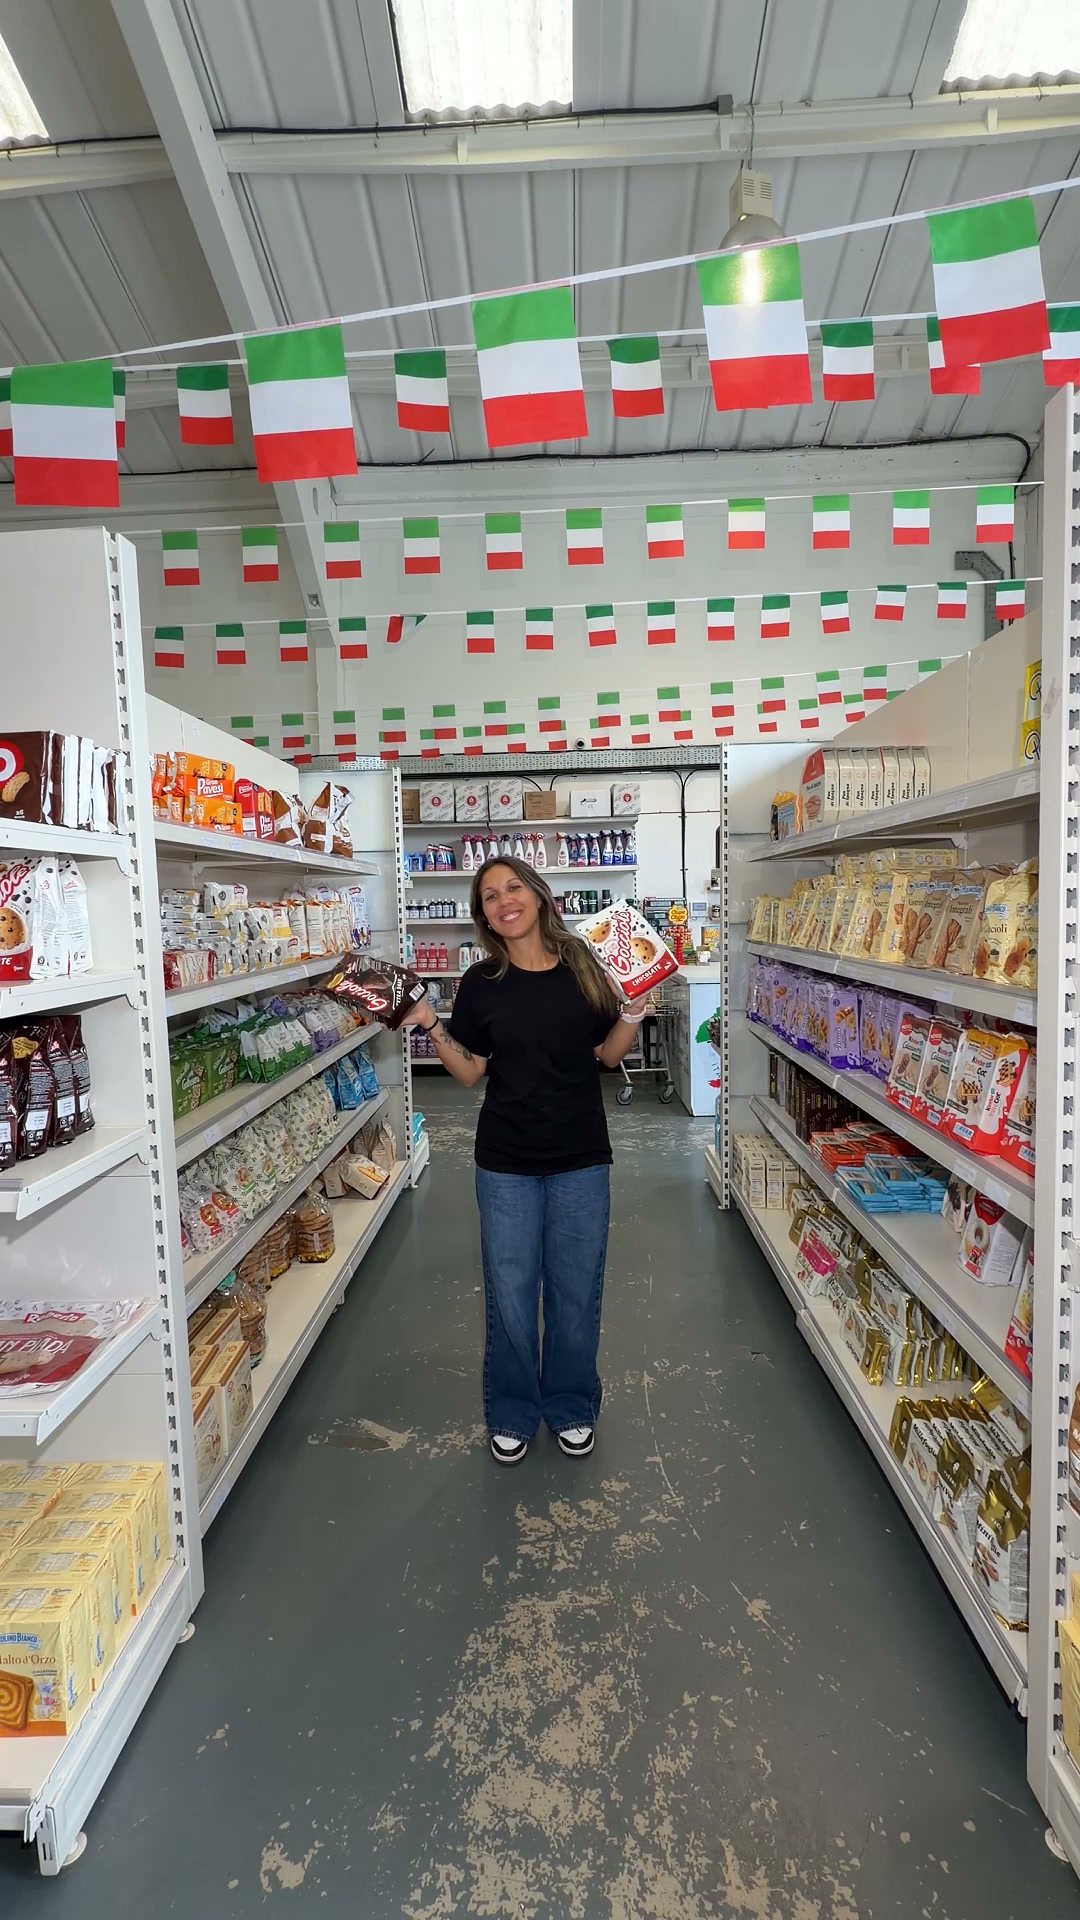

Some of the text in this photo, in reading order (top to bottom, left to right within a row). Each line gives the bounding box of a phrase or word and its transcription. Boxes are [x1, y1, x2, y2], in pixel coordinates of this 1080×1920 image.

[608, 911, 632, 976] Gocciole
[632, 963, 662, 987] CHOCOLATE
[336, 980, 388, 1011] Gocciole
[17, 1632, 38, 1644] BIANCO
[22, 1653, 56, 1665] d'Orzo
